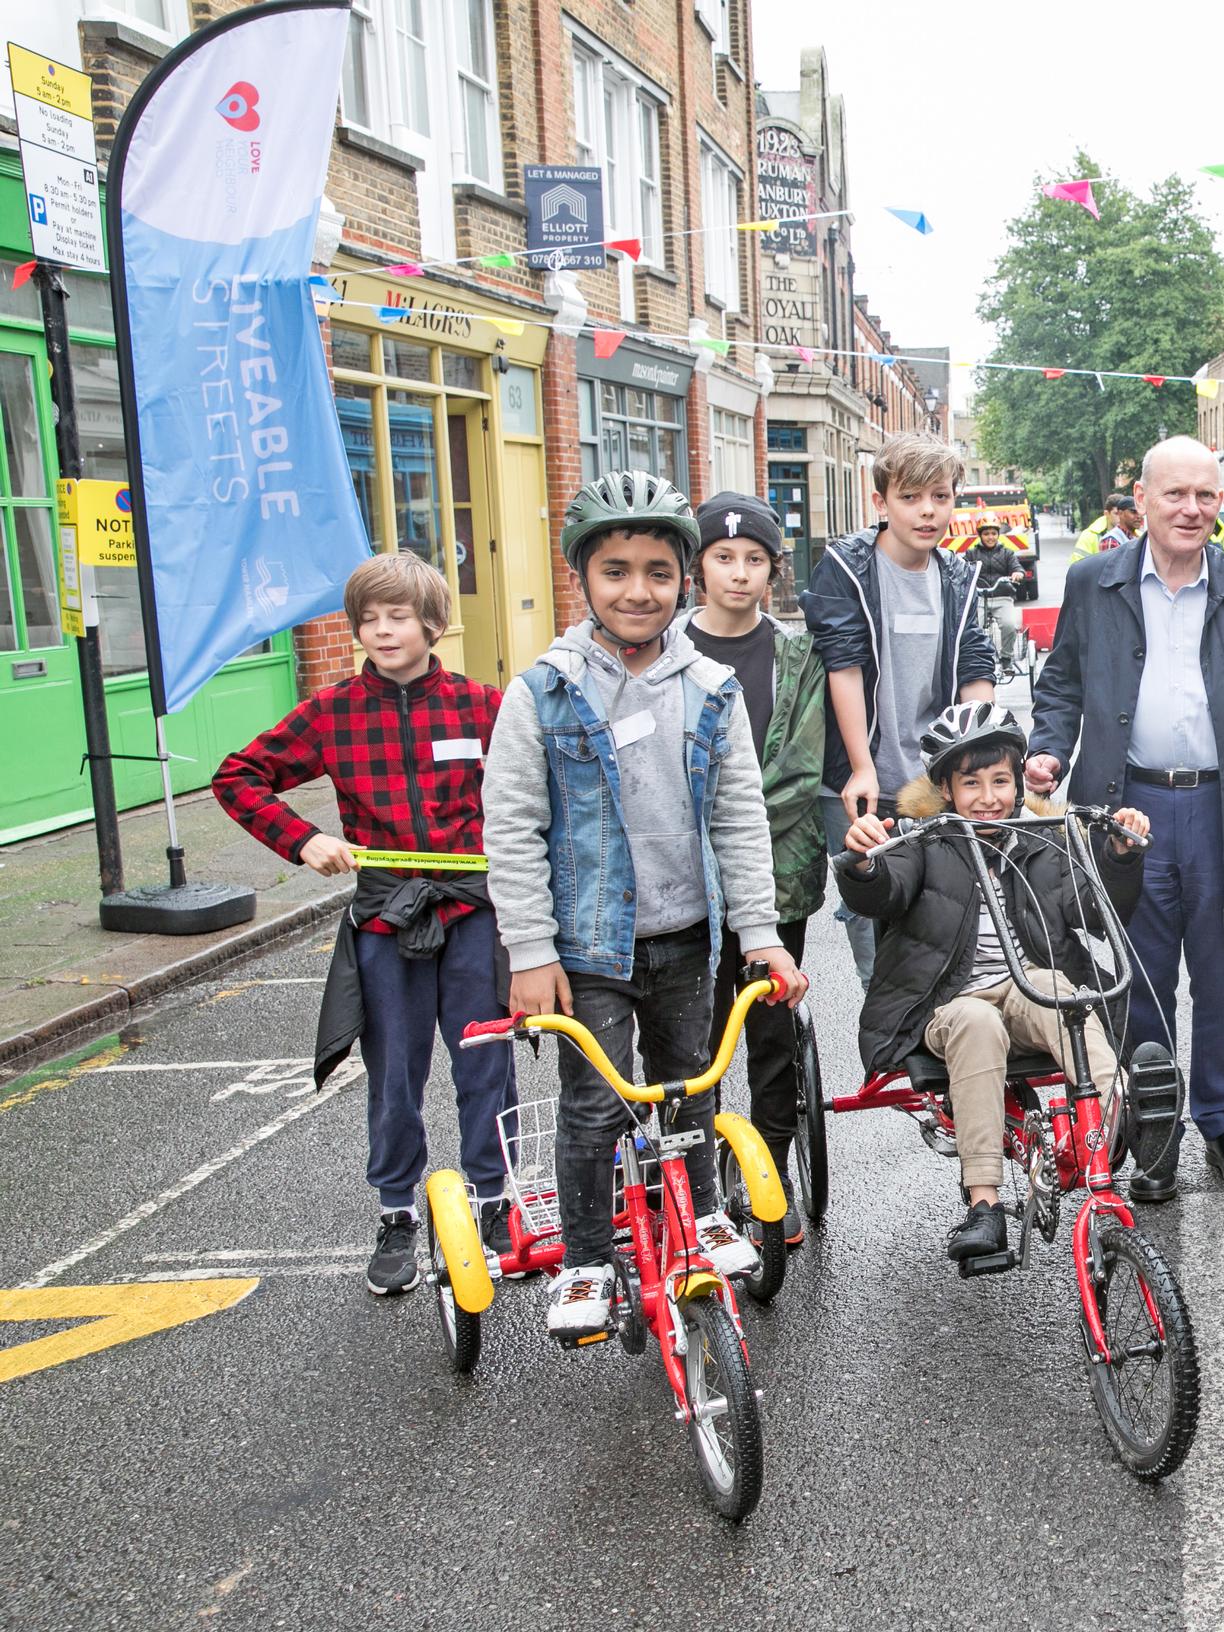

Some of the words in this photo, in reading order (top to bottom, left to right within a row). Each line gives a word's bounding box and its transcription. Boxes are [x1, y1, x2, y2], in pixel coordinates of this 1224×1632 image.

[41, 76, 65, 94] Sunday
[38, 106, 48, 117] No
[49, 111, 73, 128] loading
[46, 122, 69, 140] Sunday
[757, 130, 801, 159] 1923
[250, 141, 261, 175] LOVE
[527, 169, 545, 179] LET
[546, 170, 553, 179] &
[554, 170, 599, 180] MANAGED
[758, 159, 811, 182] RUMAN
[57, 175, 70, 188] Mon
[758, 183, 809, 205] ANBURY
[50, 197, 70, 213] Permit
[72, 205, 94, 219] holders
[758, 201, 809, 223] UXTON
[52, 220, 65, 232] Pay
[73, 228, 97, 241] machine
[542, 222, 589, 233] ELLIOTT
[55, 232, 77, 248] Display
[79, 240, 96, 252] ticket
[542, 234, 590, 243] PROPERTY
[52, 245, 65, 256] Max
[66, 250, 79, 261] stay
[86, 254, 101, 266] hours
[583, 256, 602, 266] 310
[765, 275, 797, 293] THE
[763, 298, 812, 321] OYAL
[765, 325, 802, 347] OAK
[192, 279, 250, 503] STREETS
[231, 273, 301, 521] LIVEABLE
[508, 384, 522, 410] 63
[96, 518, 131, 533] NOT
[108, 539, 136, 549] Parki
[99, 552, 136, 562] suspen
